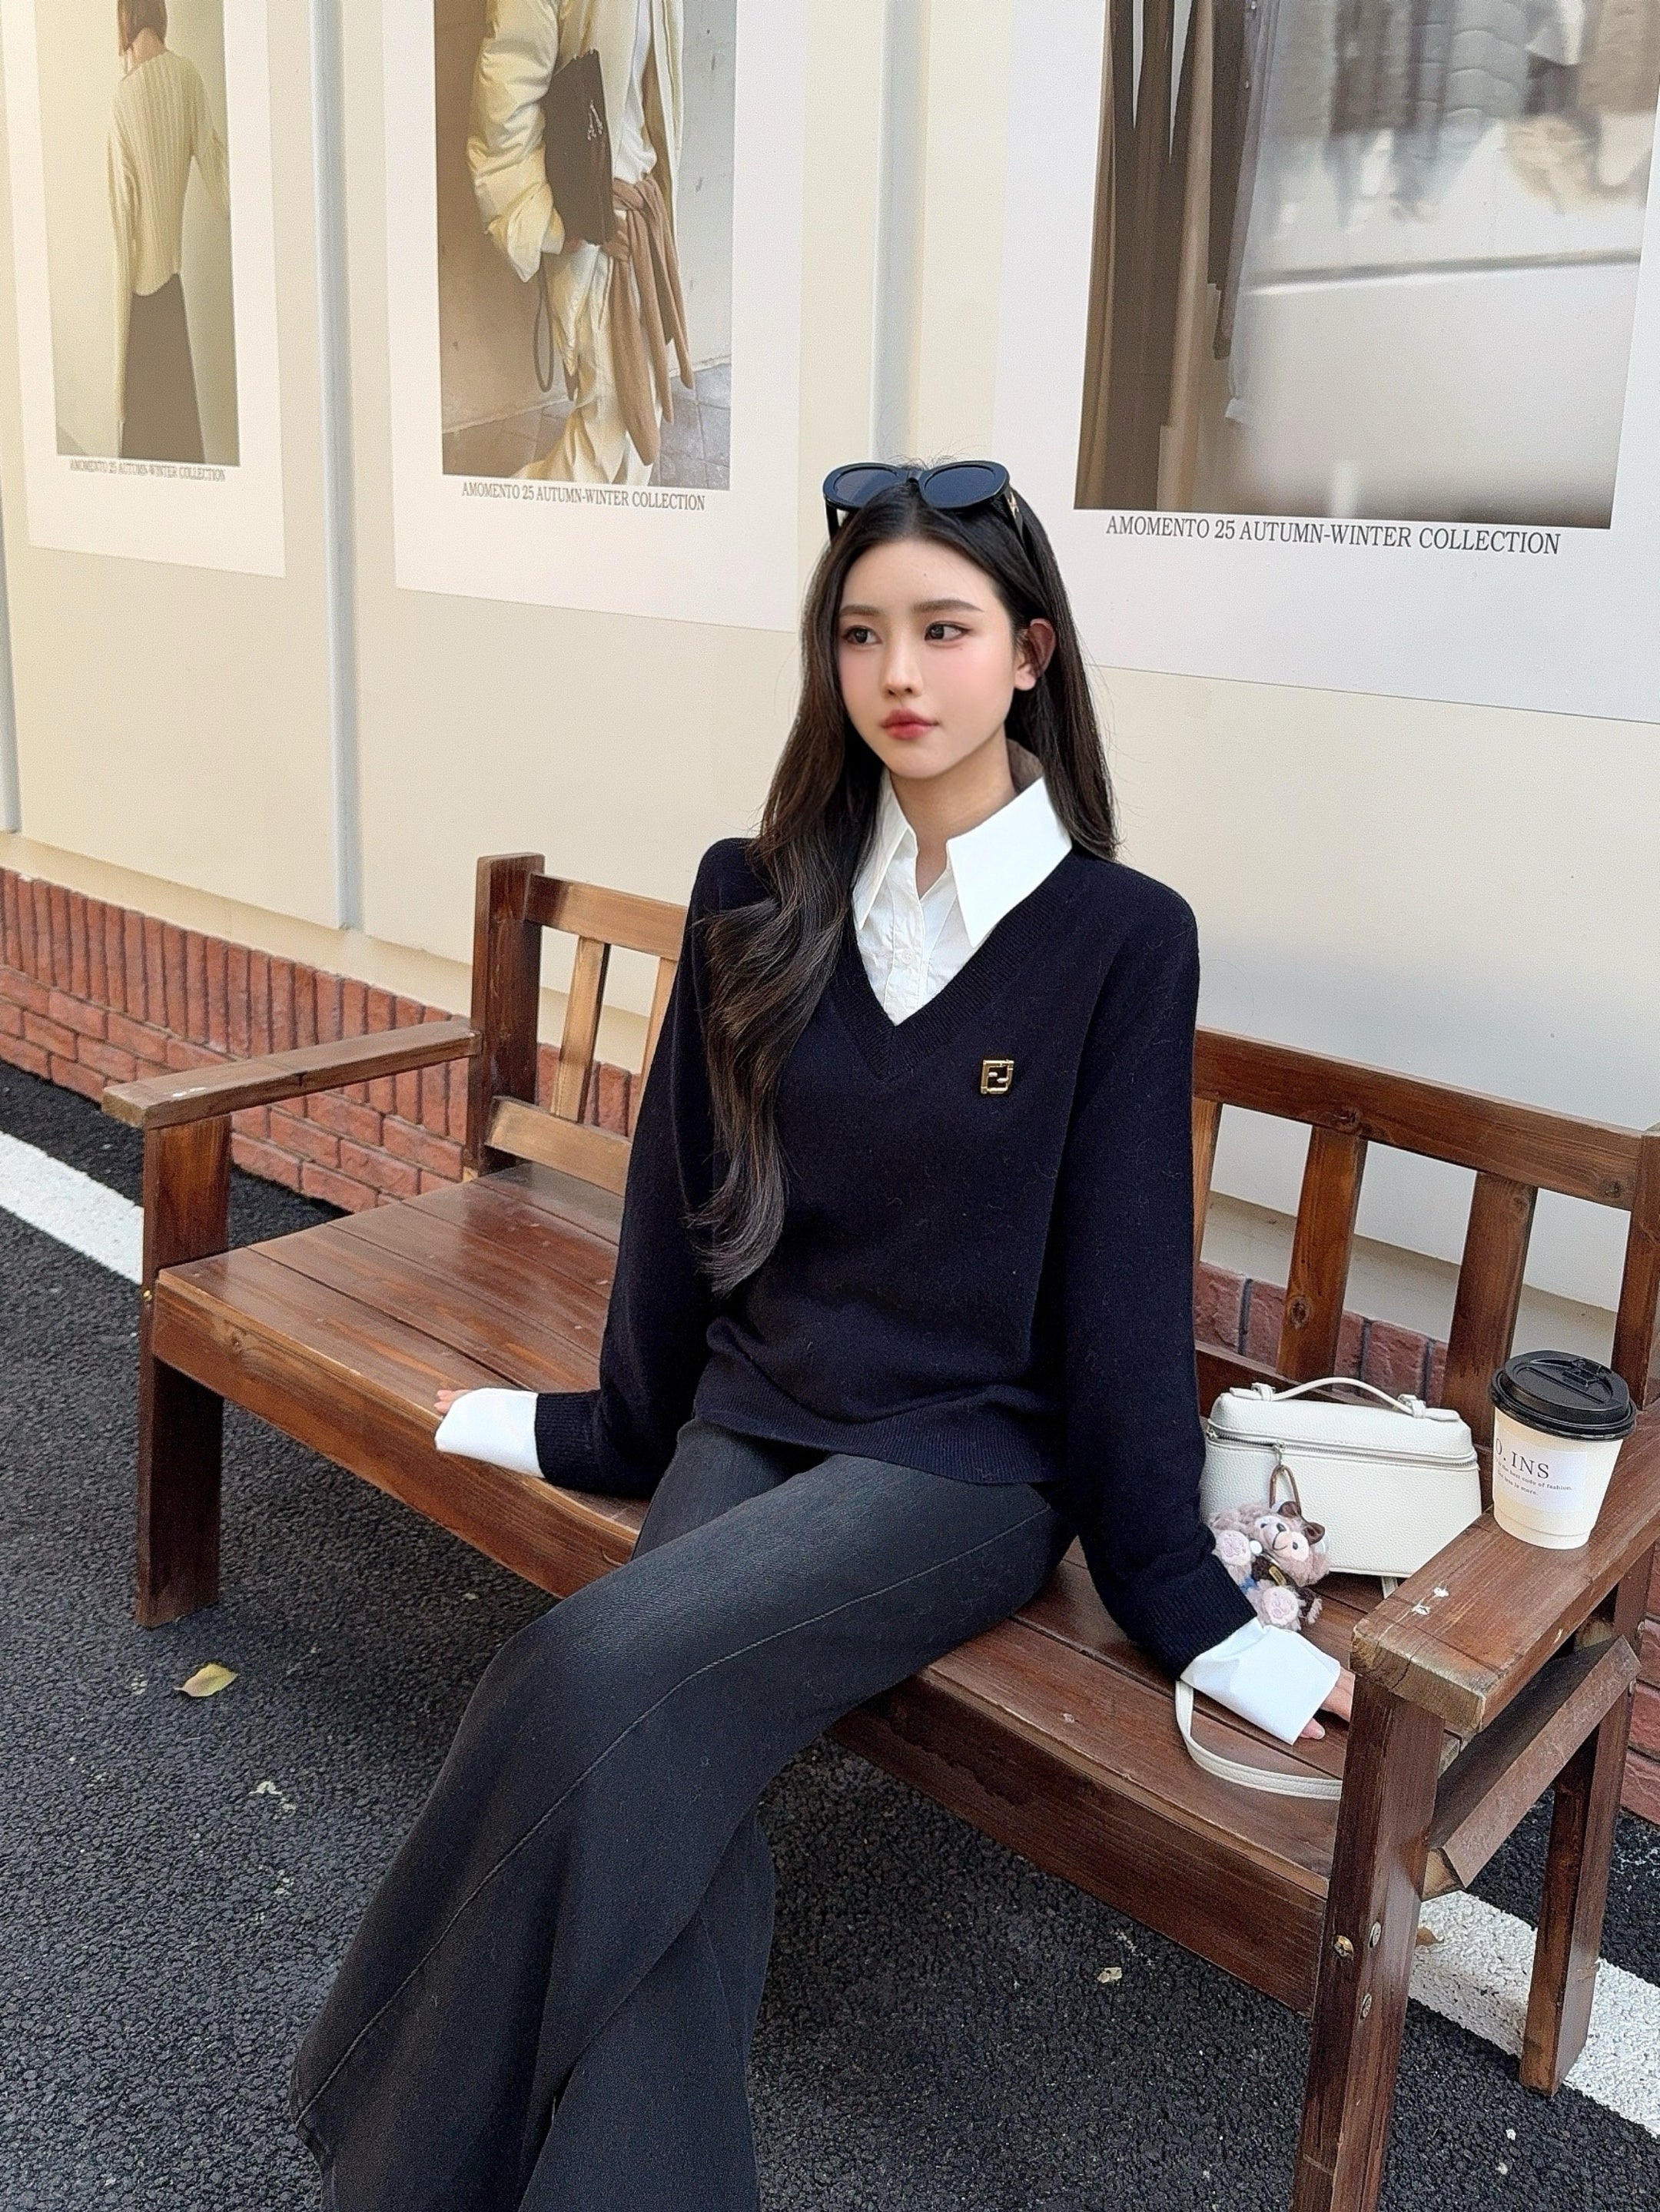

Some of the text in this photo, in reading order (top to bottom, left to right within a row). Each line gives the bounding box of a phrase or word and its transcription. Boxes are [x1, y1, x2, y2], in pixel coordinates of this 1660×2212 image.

[462, 481, 706, 511] AMOMENTO 25 AUTUMN-WINTER COLLECTION
[1106, 516, 1561, 555] AMOMENTO 25 AUTUMN-WINTER COLLECTION
